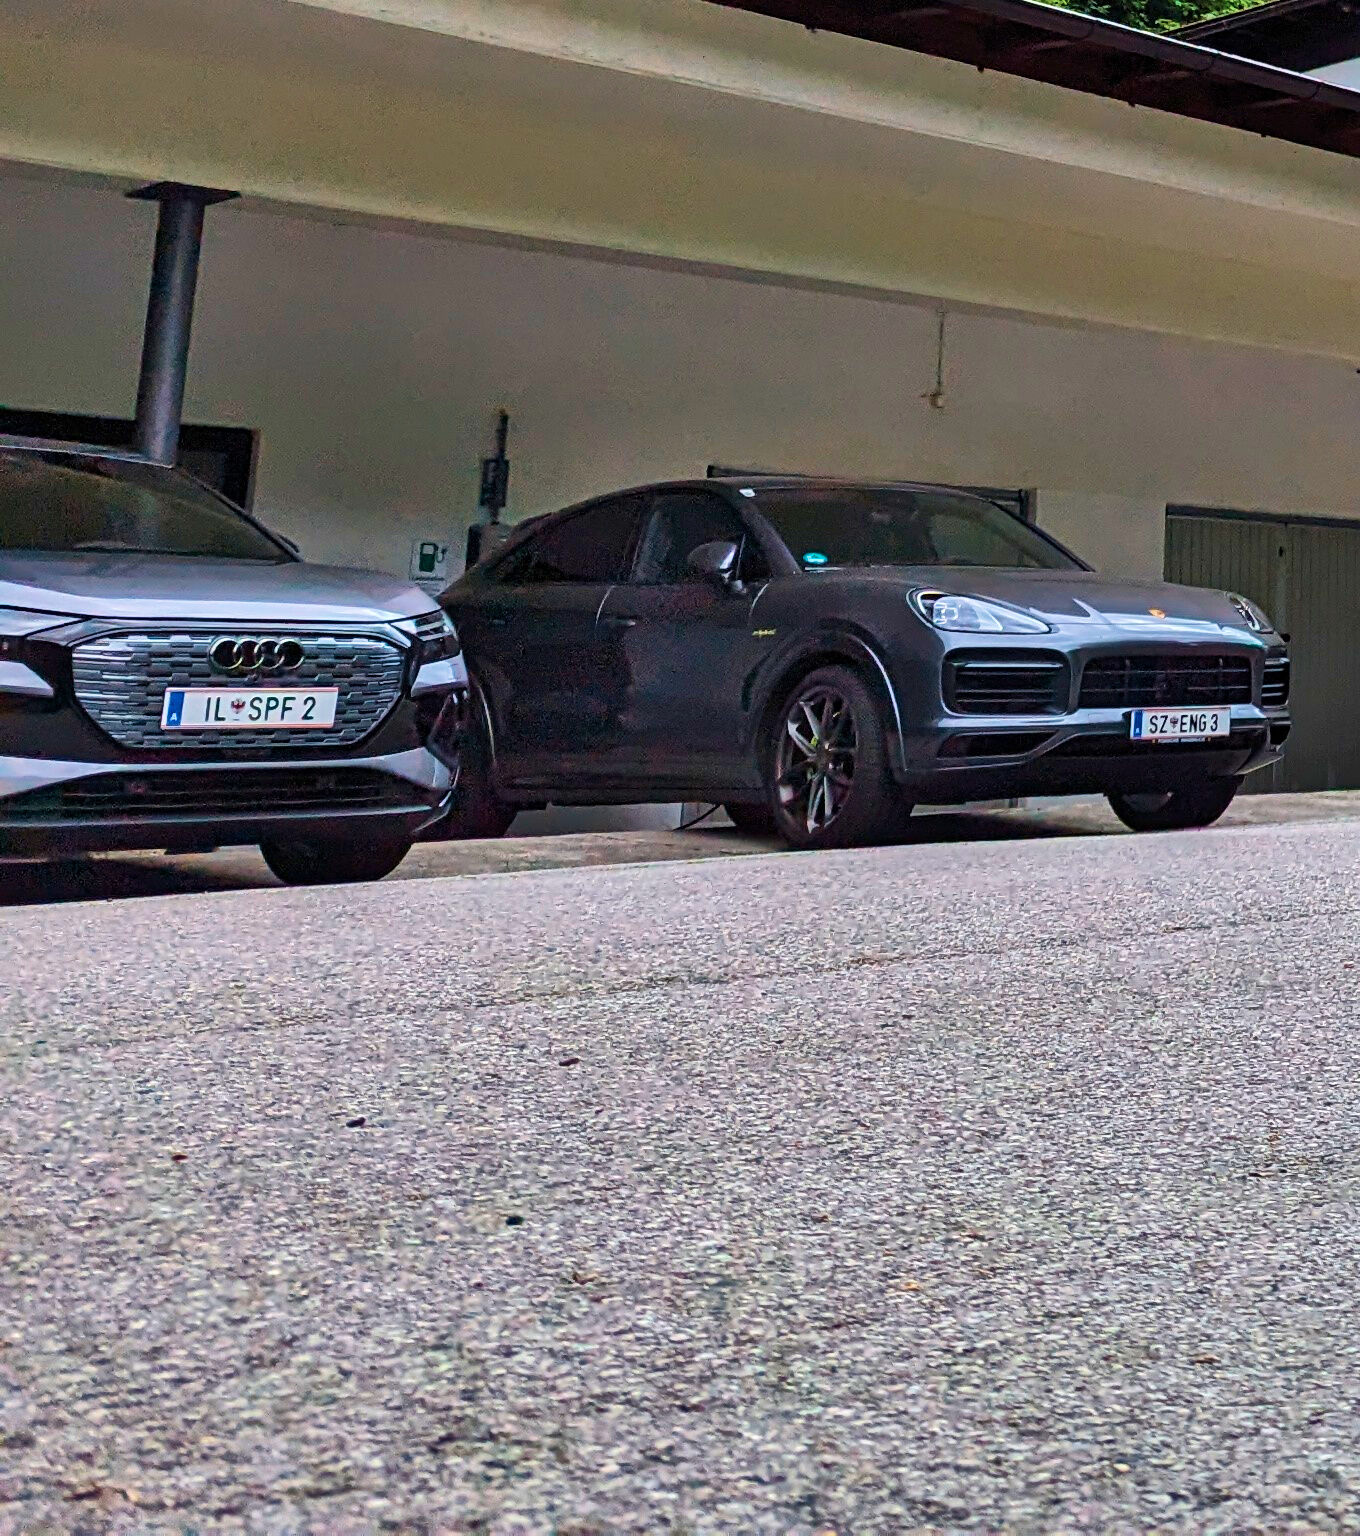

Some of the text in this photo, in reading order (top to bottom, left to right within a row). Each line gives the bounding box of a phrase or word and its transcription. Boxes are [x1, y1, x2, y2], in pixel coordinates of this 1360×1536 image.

[204, 696, 227, 722] IL
[248, 696, 297, 722] SPF
[301, 696, 317, 721] 2
[1149, 713, 1219, 734] SZ ENG 3
